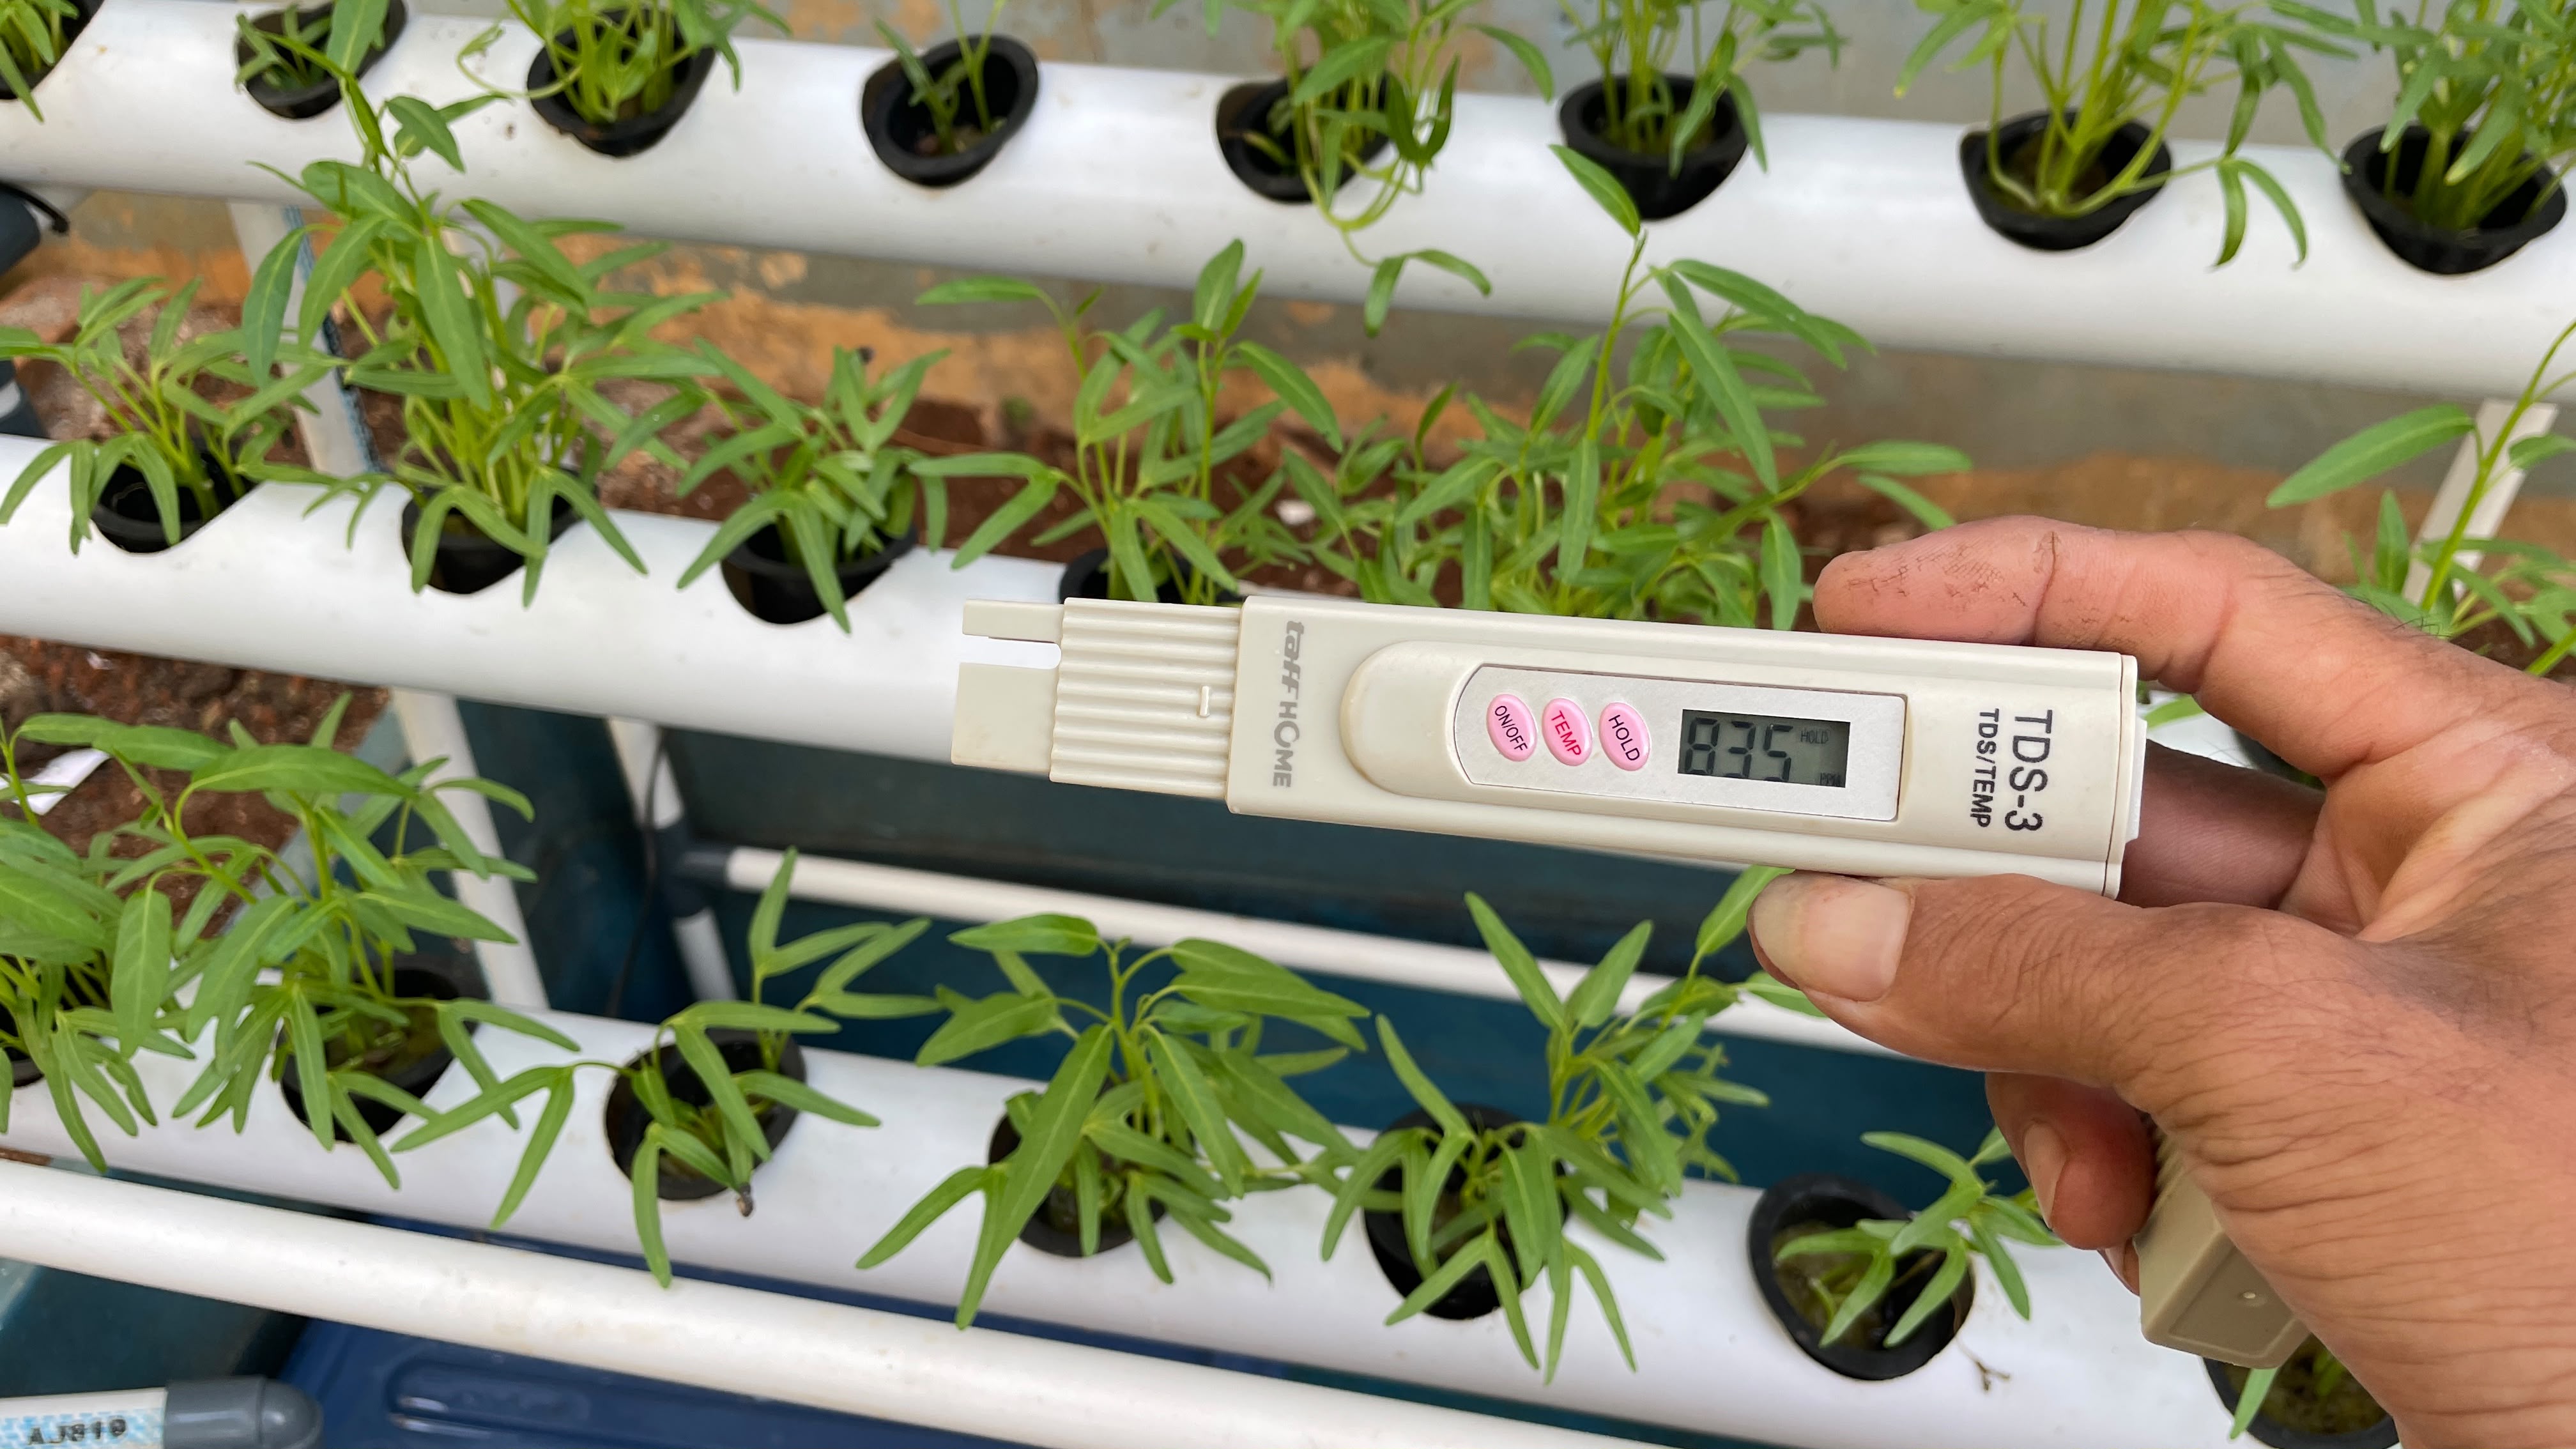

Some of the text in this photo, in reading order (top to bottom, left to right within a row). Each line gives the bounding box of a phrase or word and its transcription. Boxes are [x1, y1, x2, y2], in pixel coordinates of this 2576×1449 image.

[1494, 705, 1528, 751] ON/OFF
[1551, 710, 1582, 756] TEMP
[1608, 714, 1641, 762] HOLD
[1684, 717, 1794, 781] 835
[1800, 729, 1829, 744] HOLD
[1970, 707, 2000, 828] TDS/TEMP
[2004, 709, 2053, 832] TDS-3
